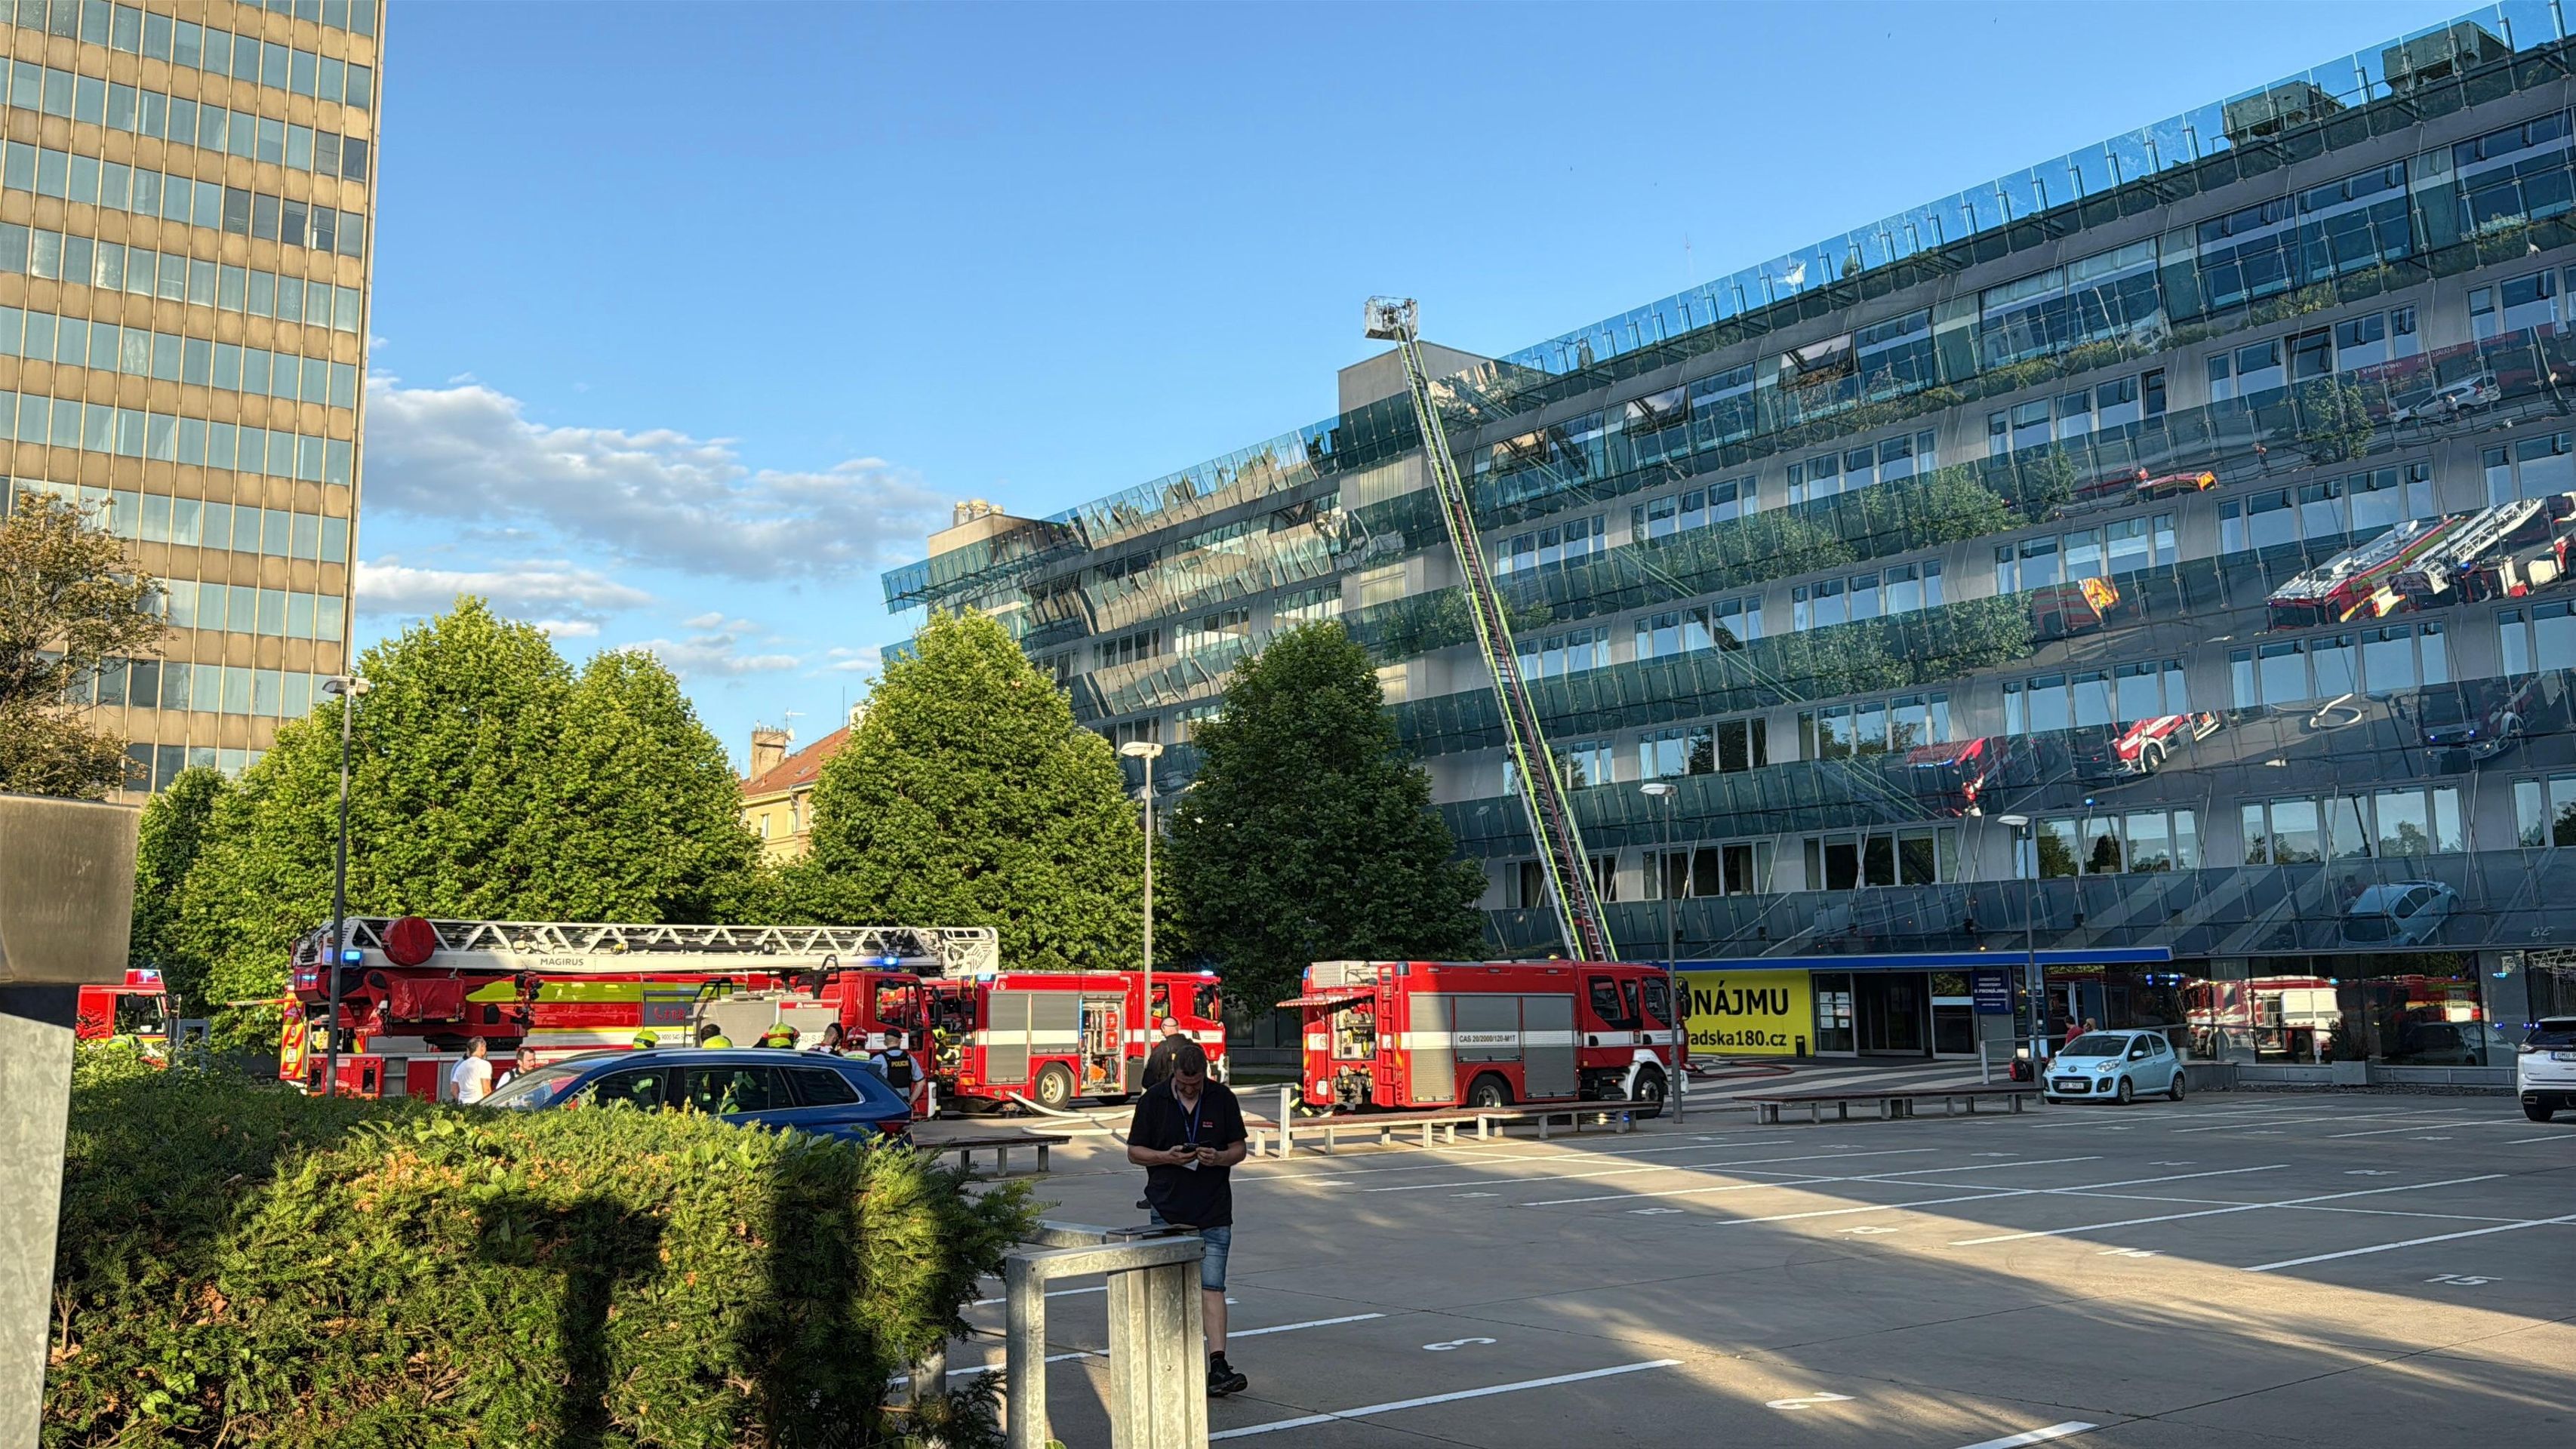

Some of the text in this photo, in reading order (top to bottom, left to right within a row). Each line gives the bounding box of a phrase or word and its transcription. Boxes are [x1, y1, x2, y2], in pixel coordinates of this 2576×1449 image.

[540, 958, 584, 966] MAGIRUS
[1688, 980, 1789, 1016] NÁJMU
[1459, 1035, 1472, 1043] CAS
[1688, 1029, 1787, 1047] adska180.cz
[2424, 1273, 2504, 1285] 15
